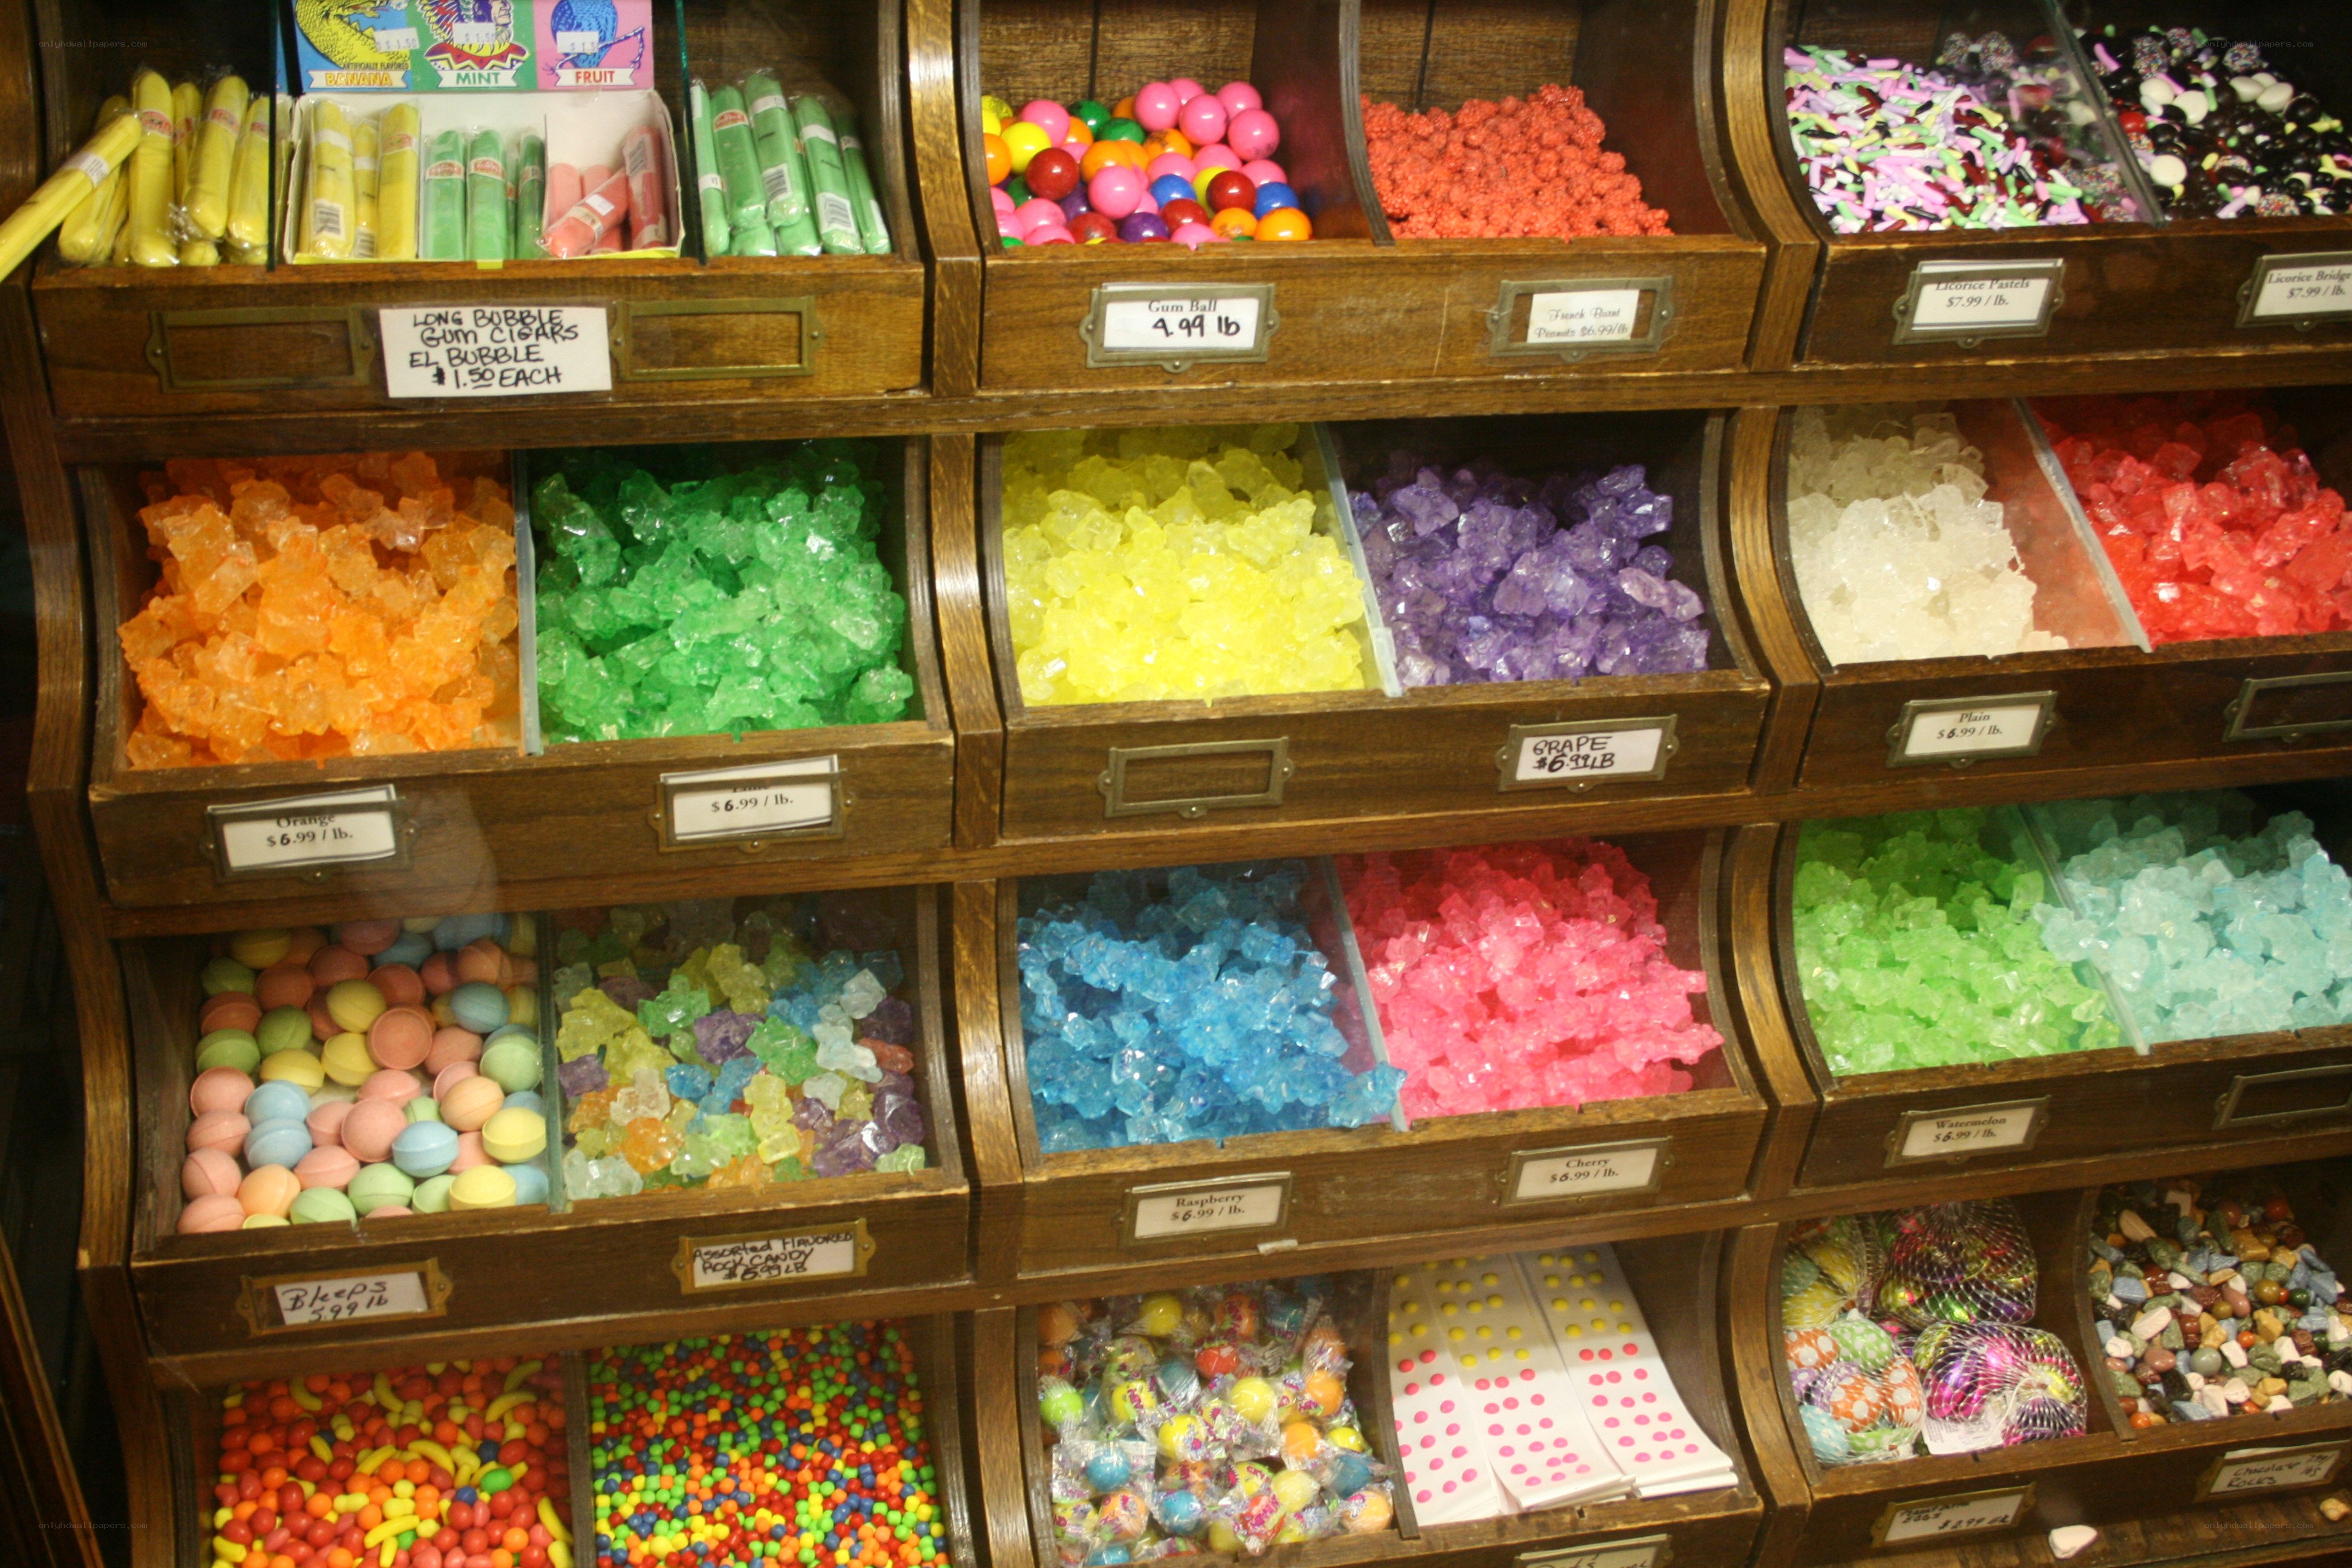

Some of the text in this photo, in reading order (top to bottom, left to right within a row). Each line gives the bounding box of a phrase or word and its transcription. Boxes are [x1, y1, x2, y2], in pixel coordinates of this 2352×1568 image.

[325, 72, 393, 87] BANANA
[456, 73, 500, 85] MINT
[575, 70, 615, 83] FRUIT
[1989, 278, 2030, 289] Pastels
[2268, 272, 2313, 284] Licorice
[2287, 287, 2322, 299] $7.99
[2331, 284, 2346, 296] lb.
[1148, 299, 1218, 313] Gum Ball
[1946, 295, 1982, 308] $7.99
[1993, 294, 2010, 306] lb.
[414, 309, 563, 330] LONG BUBBLE
[1549, 307, 1621, 321] French Burnt
[1217, 315, 1240, 336] lb
[490, 324, 579, 344] CIGARS
[1534, 327, 1575, 339] Peanuts
[409, 344, 544, 368] EL BUBBLE
[498, 366, 562, 388] EACH
[1959, 711, 1991, 724] Plain
[1987, 725, 2003, 736] lb.
[1532, 736, 1613, 756] GRAPE
[774, 793, 794, 806] lb.
[276, 815, 336, 829] Orange
[333, 827, 354, 840] lb.
[1936, 1116, 2007, 1129] Watermelon
[1981, 1129, 1996, 1138] lb.
[1566, 1158, 1612, 1169] Cherry
[1603, 1168, 1619, 1178] lb.
[1175, 1194, 1245, 1208] Raspberry
[1228, 1206, 1246, 1215] lb.
[750, 1247, 814, 1268] CANDY
